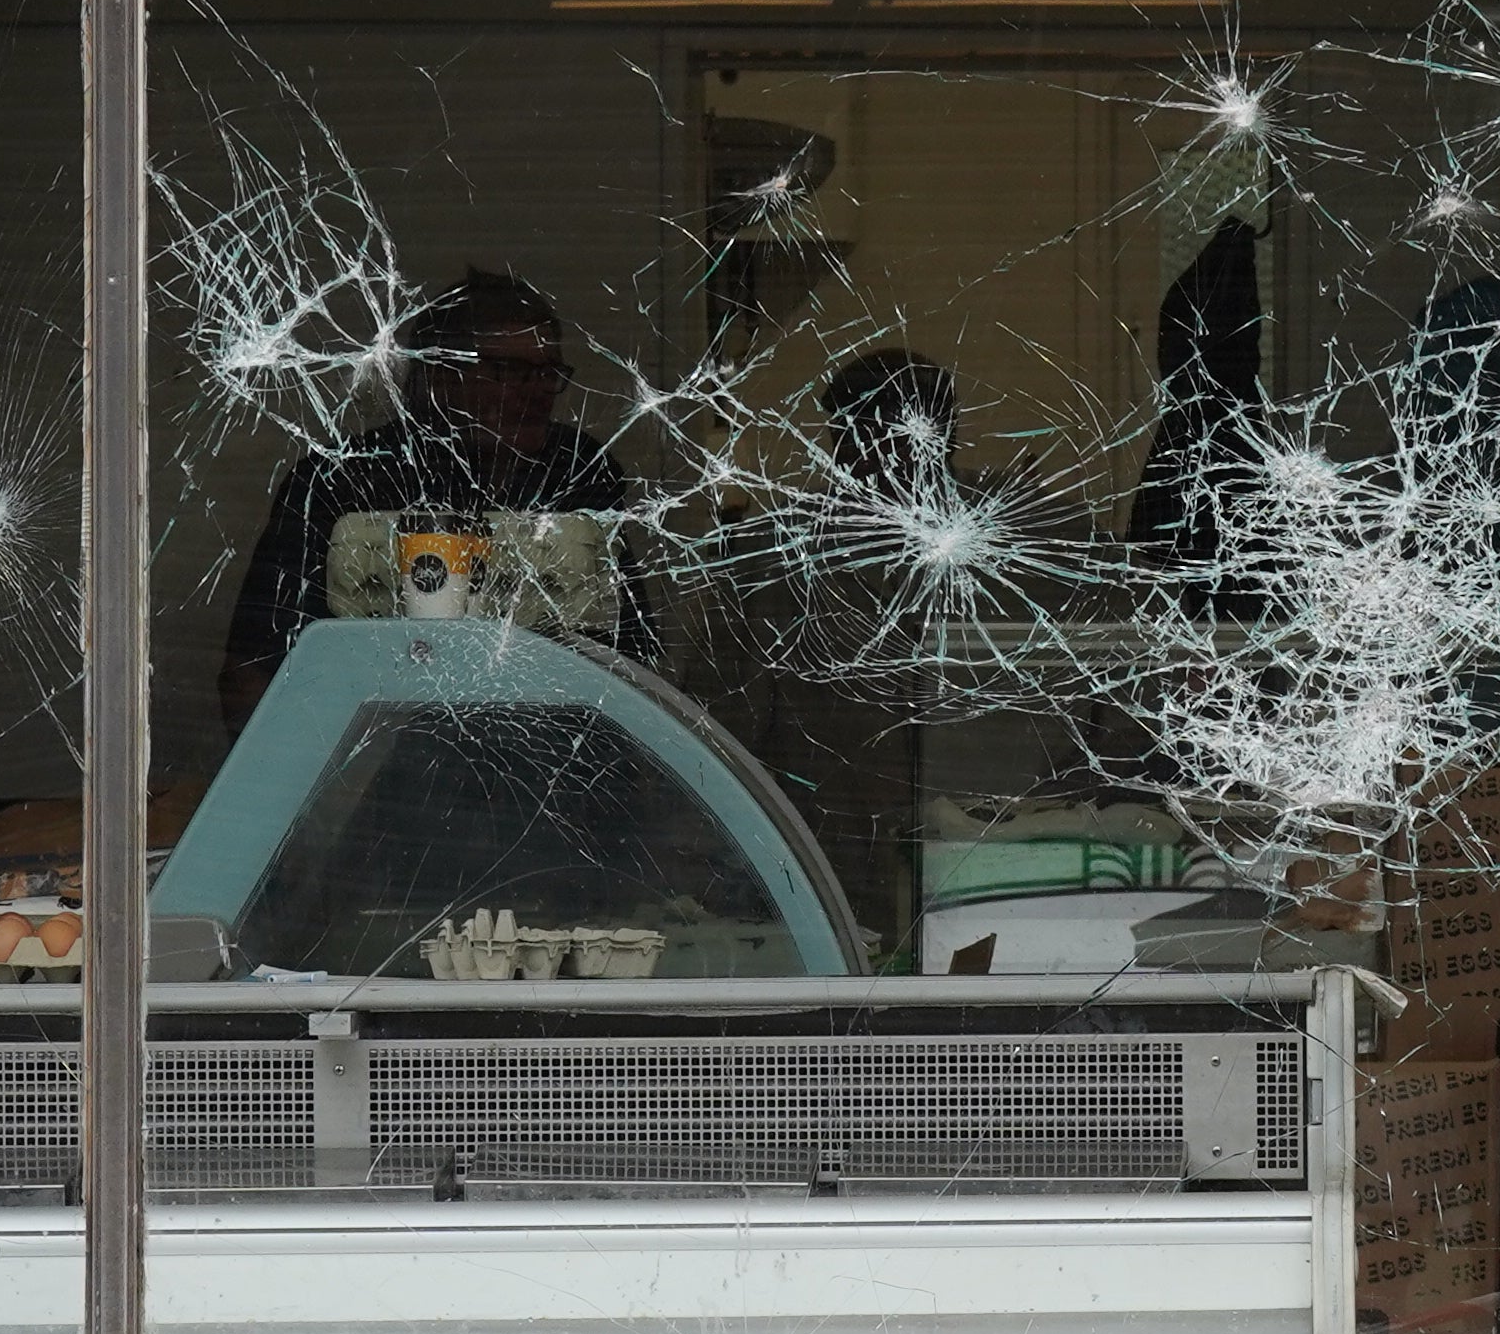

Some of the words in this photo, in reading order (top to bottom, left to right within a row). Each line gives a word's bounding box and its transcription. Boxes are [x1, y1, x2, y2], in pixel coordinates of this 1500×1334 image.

[1418, 872, 1478, 900] EGGS
[1431, 912, 1493, 940] EGGS
[1368, 1074, 1438, 1107] FRESH
[1385, 1108, 1454, 1143] FRESH
[1401, 1143, 1471, 1179] FRESH
[1367, 1252, 1428, 1284] EGGS
